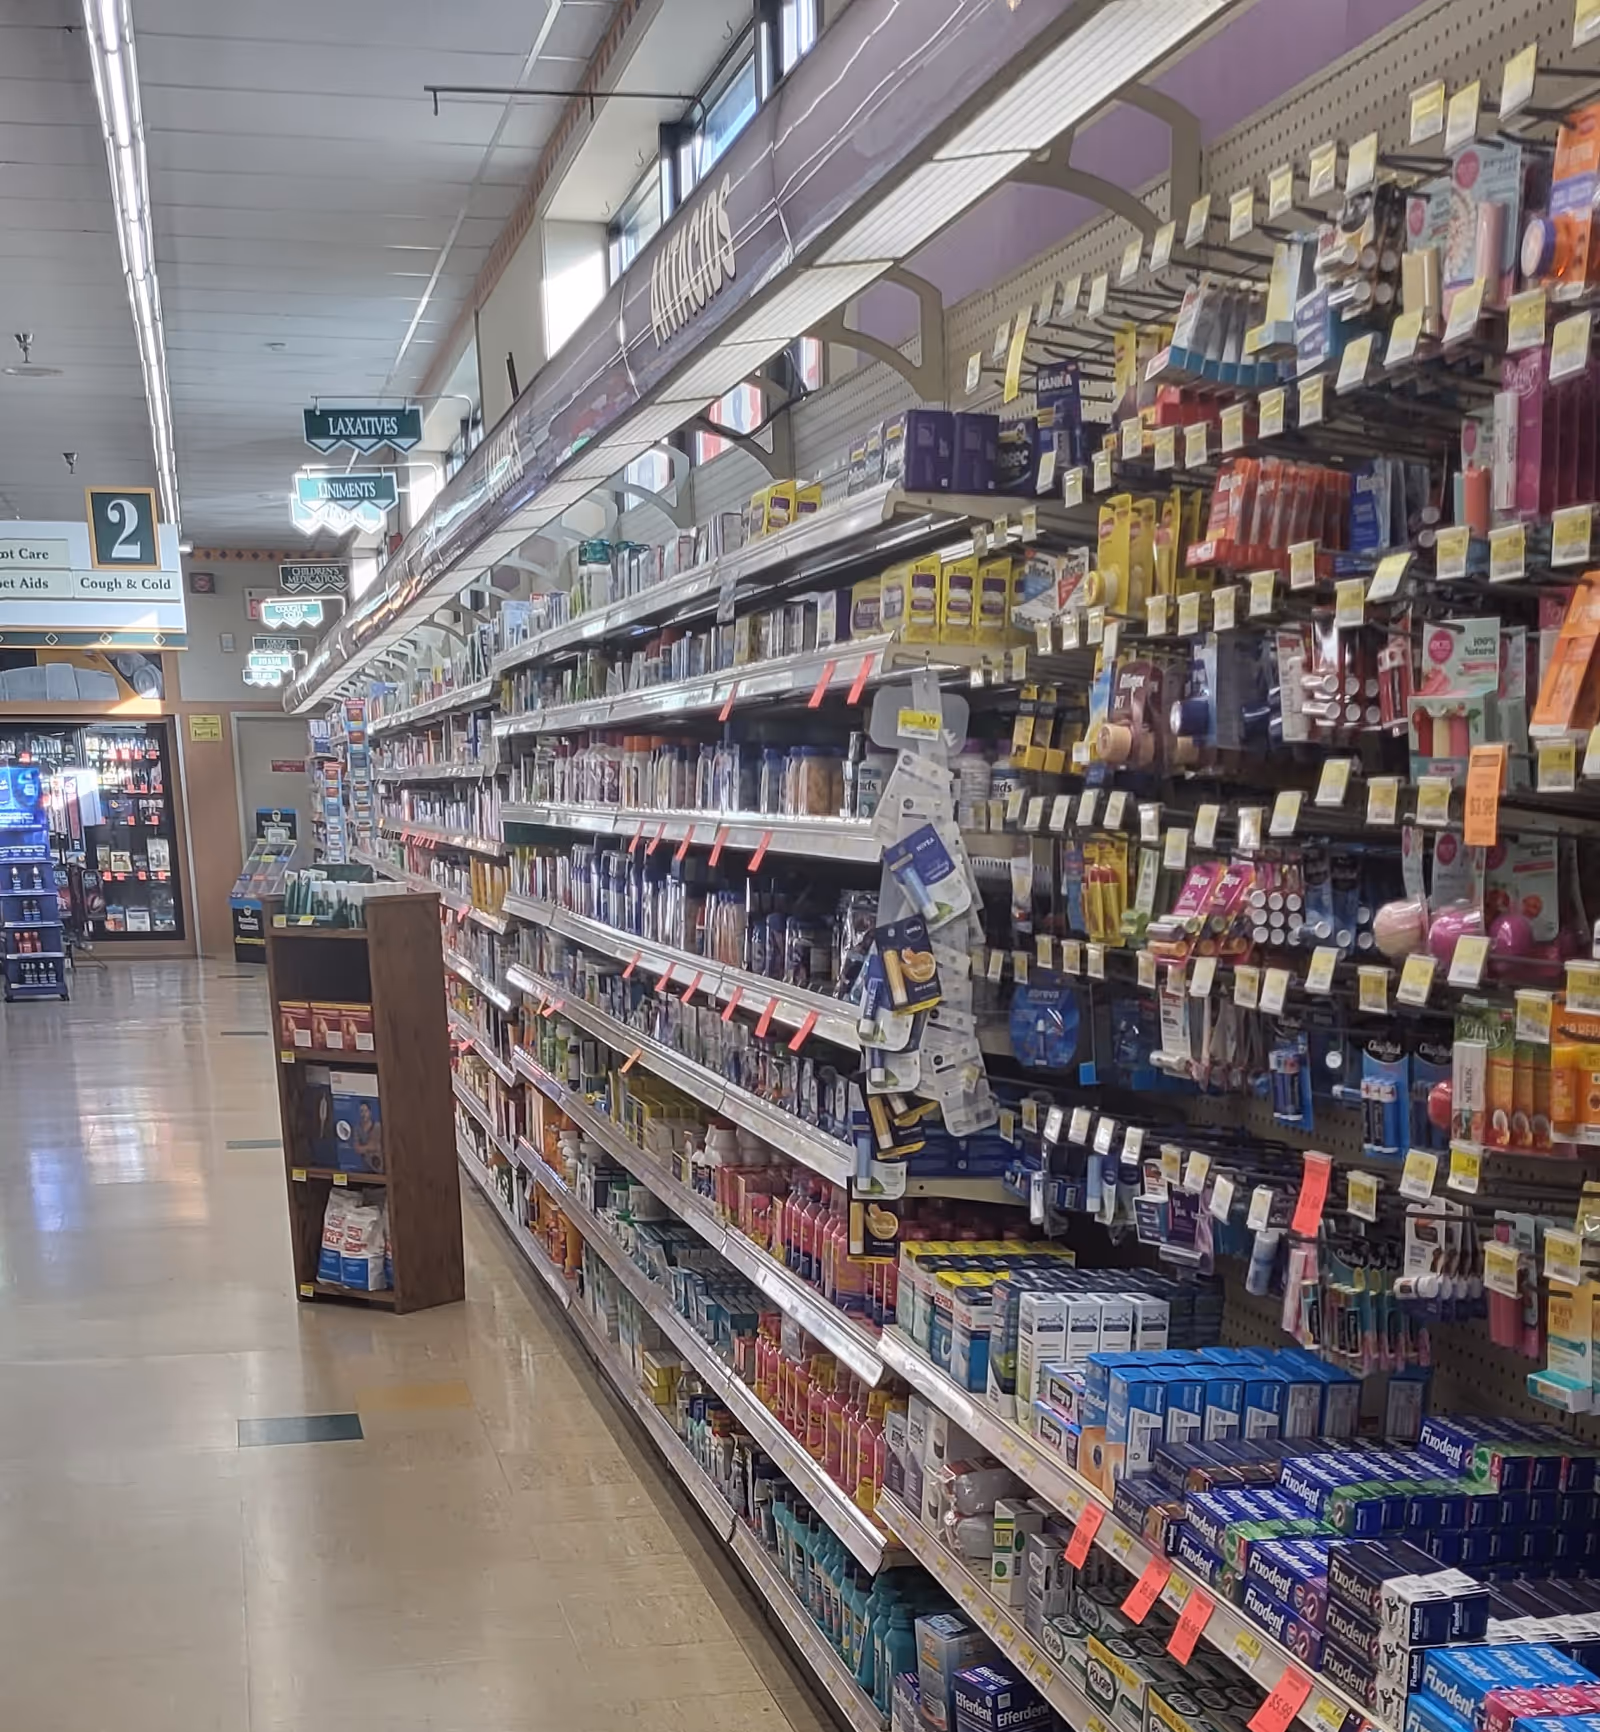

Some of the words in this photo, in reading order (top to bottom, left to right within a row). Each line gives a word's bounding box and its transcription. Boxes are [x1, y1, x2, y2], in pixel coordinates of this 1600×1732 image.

[328, 416, 398, 436] LAXATIVES
[317, 482, 376, 499] LINIMENTS
[107, 500, 141, 559] 2
[18, 548, 49, 560] Care
[20, 577, 49, 589] Aids
[80, 577, 122, 592] Cough
[127, 579, 137, 589] &
[141, 578, 171, 590] Cold
[287, 574, 345, 584] MEDICATIONS
[916, 837, 935, 852] NIVEA
[1420, 1425, 1463, 1463] Fixodent
[1280, 1467, 1320, 1505] Fixodent
[1185, 1503, 1217, 1543] Fixodent
[1178, 1537, 1213, 1577] Fixodent
[1249, 1550, 1293, 1595] Fixodent
[1330, 1558, 1371, 1604] Fixodent
[1244, 1587, 1285, 1632] Fixodent
[1325, 1602, 1369, 1648] Fixodent
[1089, 1666, 1114, 1698] POLIGRIP
[1323, 1648, 1366, 1696] Fixodent
[1410, 1654, 1420, 1688] Fixodent
[956, 1690, 993, 1723] Efferdent
[1267, 1694, 1293, 1720] $5.99
[1424, 1664, 1475, 1717] Fixodent
[997, 1701, 1049, 1727] Efferdent
